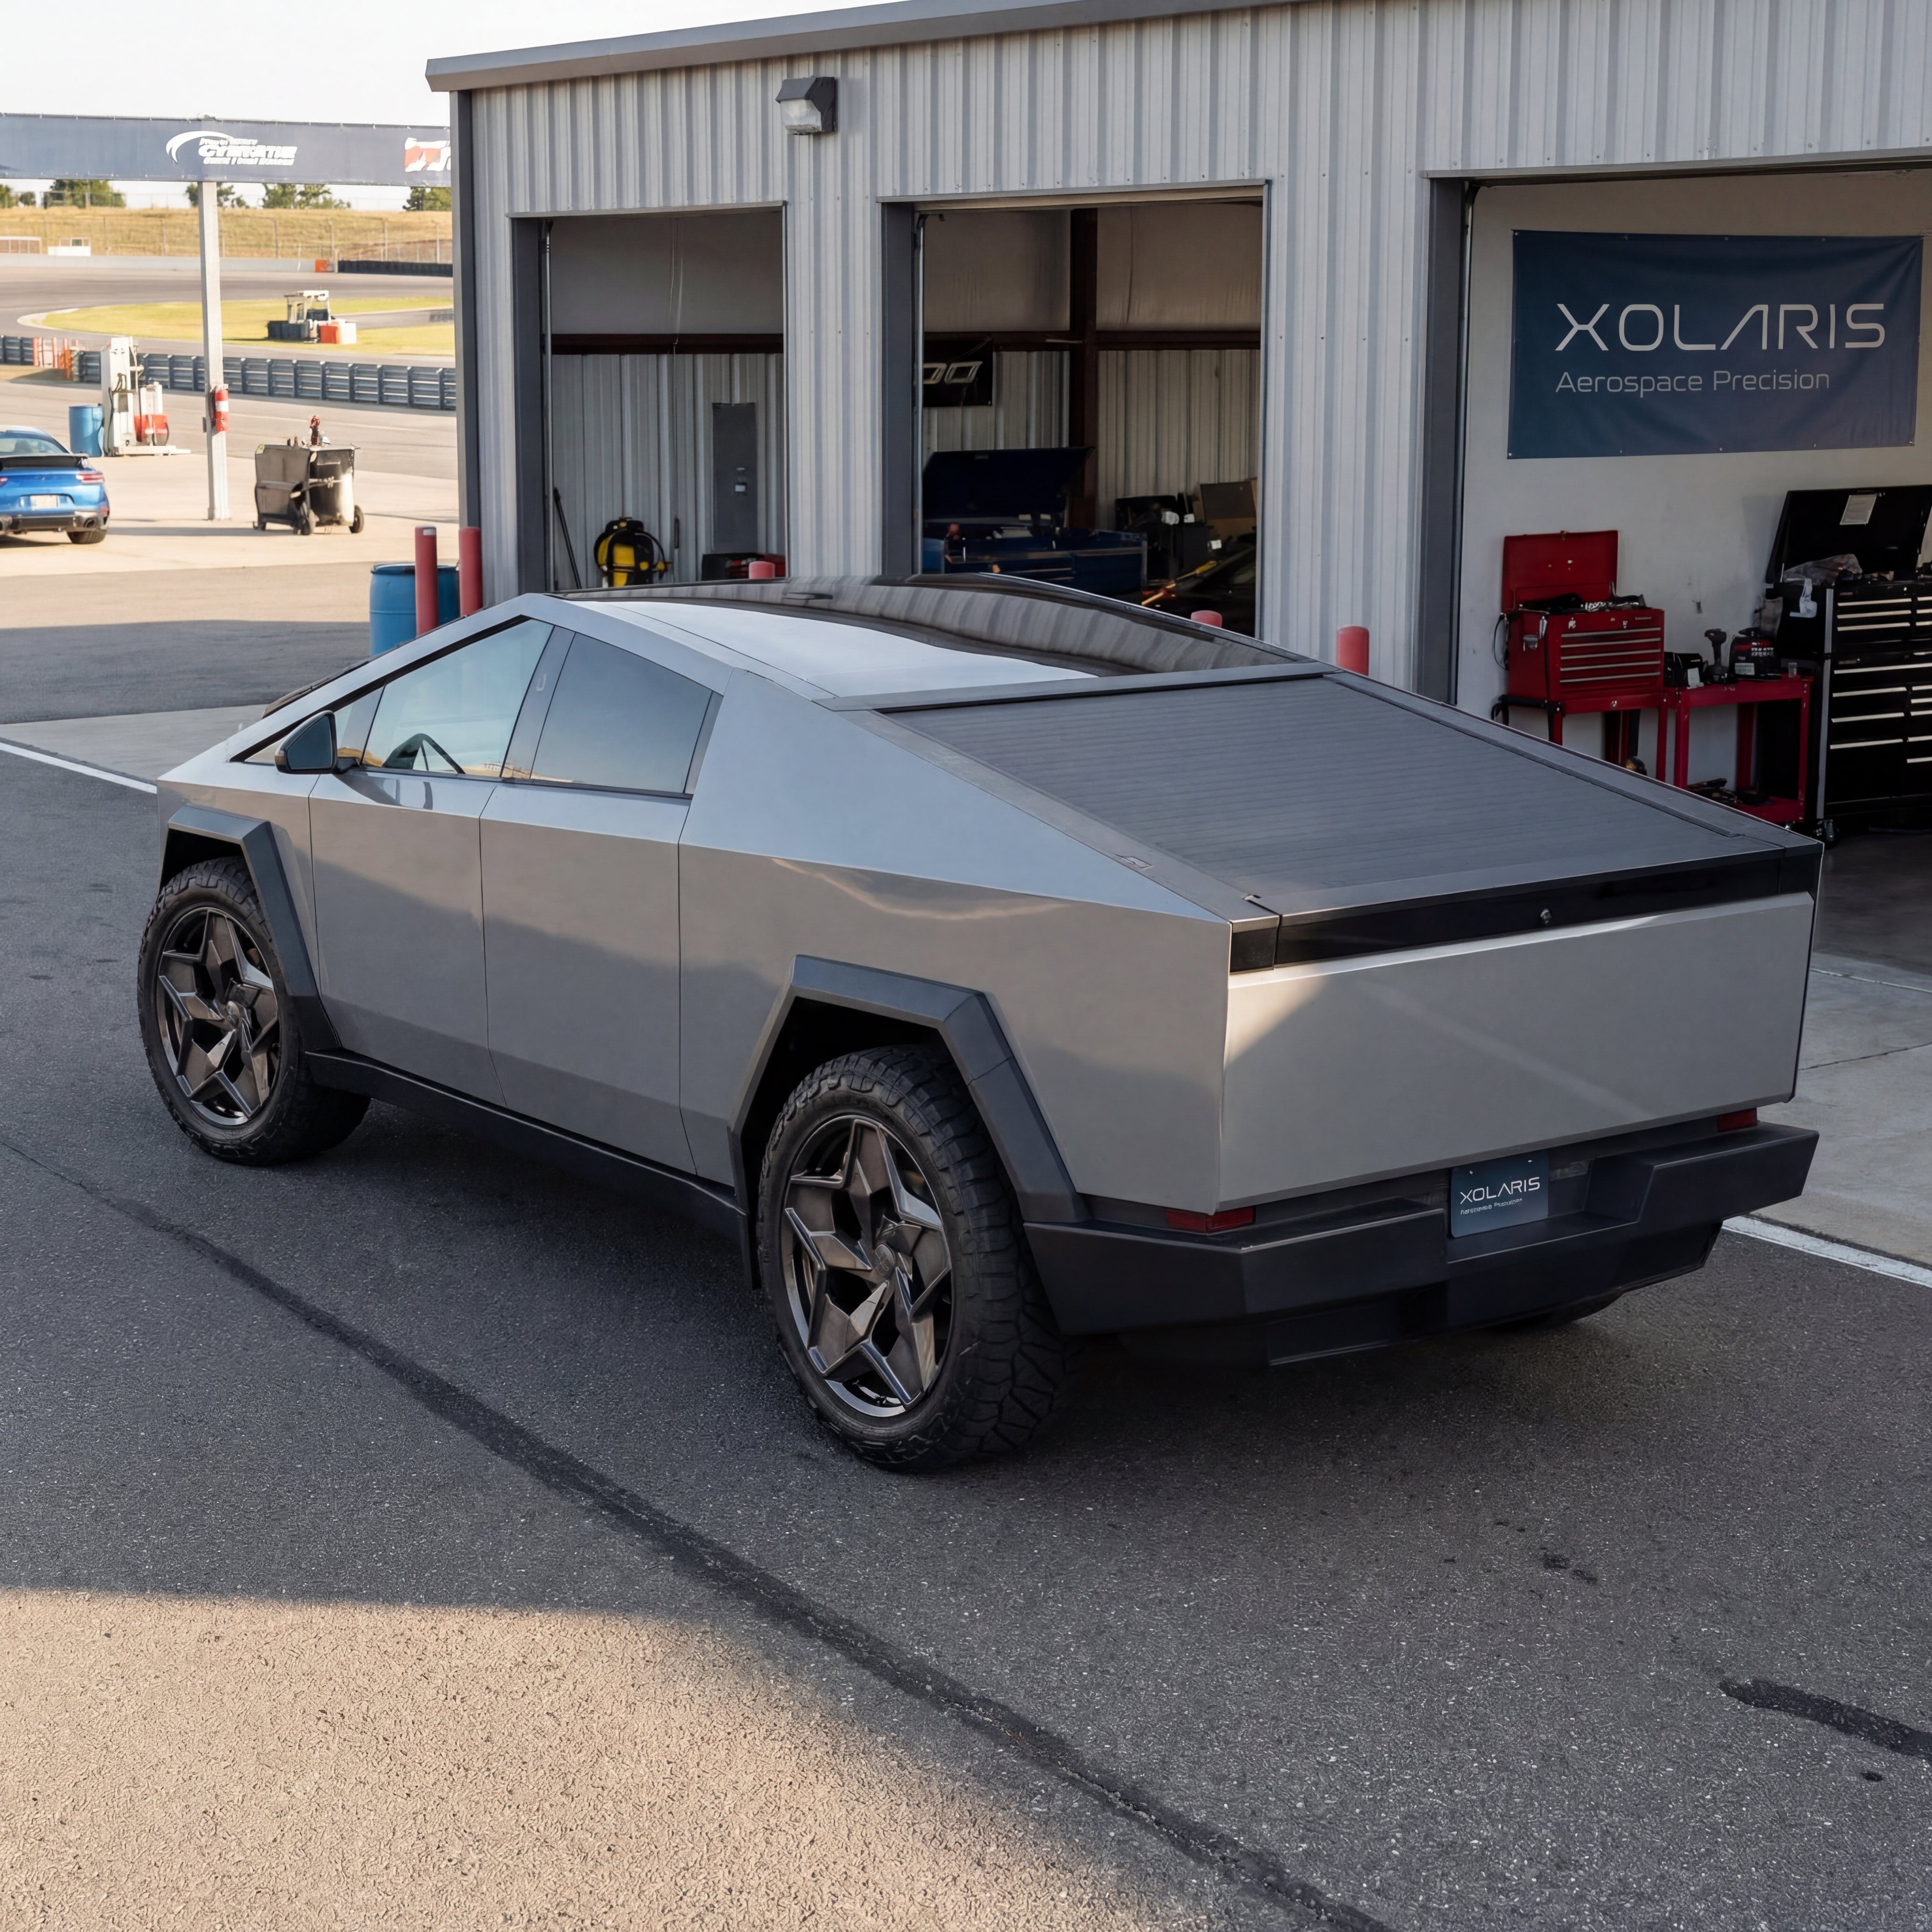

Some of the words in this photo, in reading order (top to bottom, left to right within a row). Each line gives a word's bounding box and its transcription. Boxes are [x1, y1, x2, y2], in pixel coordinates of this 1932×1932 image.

[1555, 303, 1885, 351] XOLARIS
[1555, 372, 1703, 398] Aerospace
[1713, 369, 1830, 391] Precision
[1460, 1176, 1541, 1205] XOLARIS
